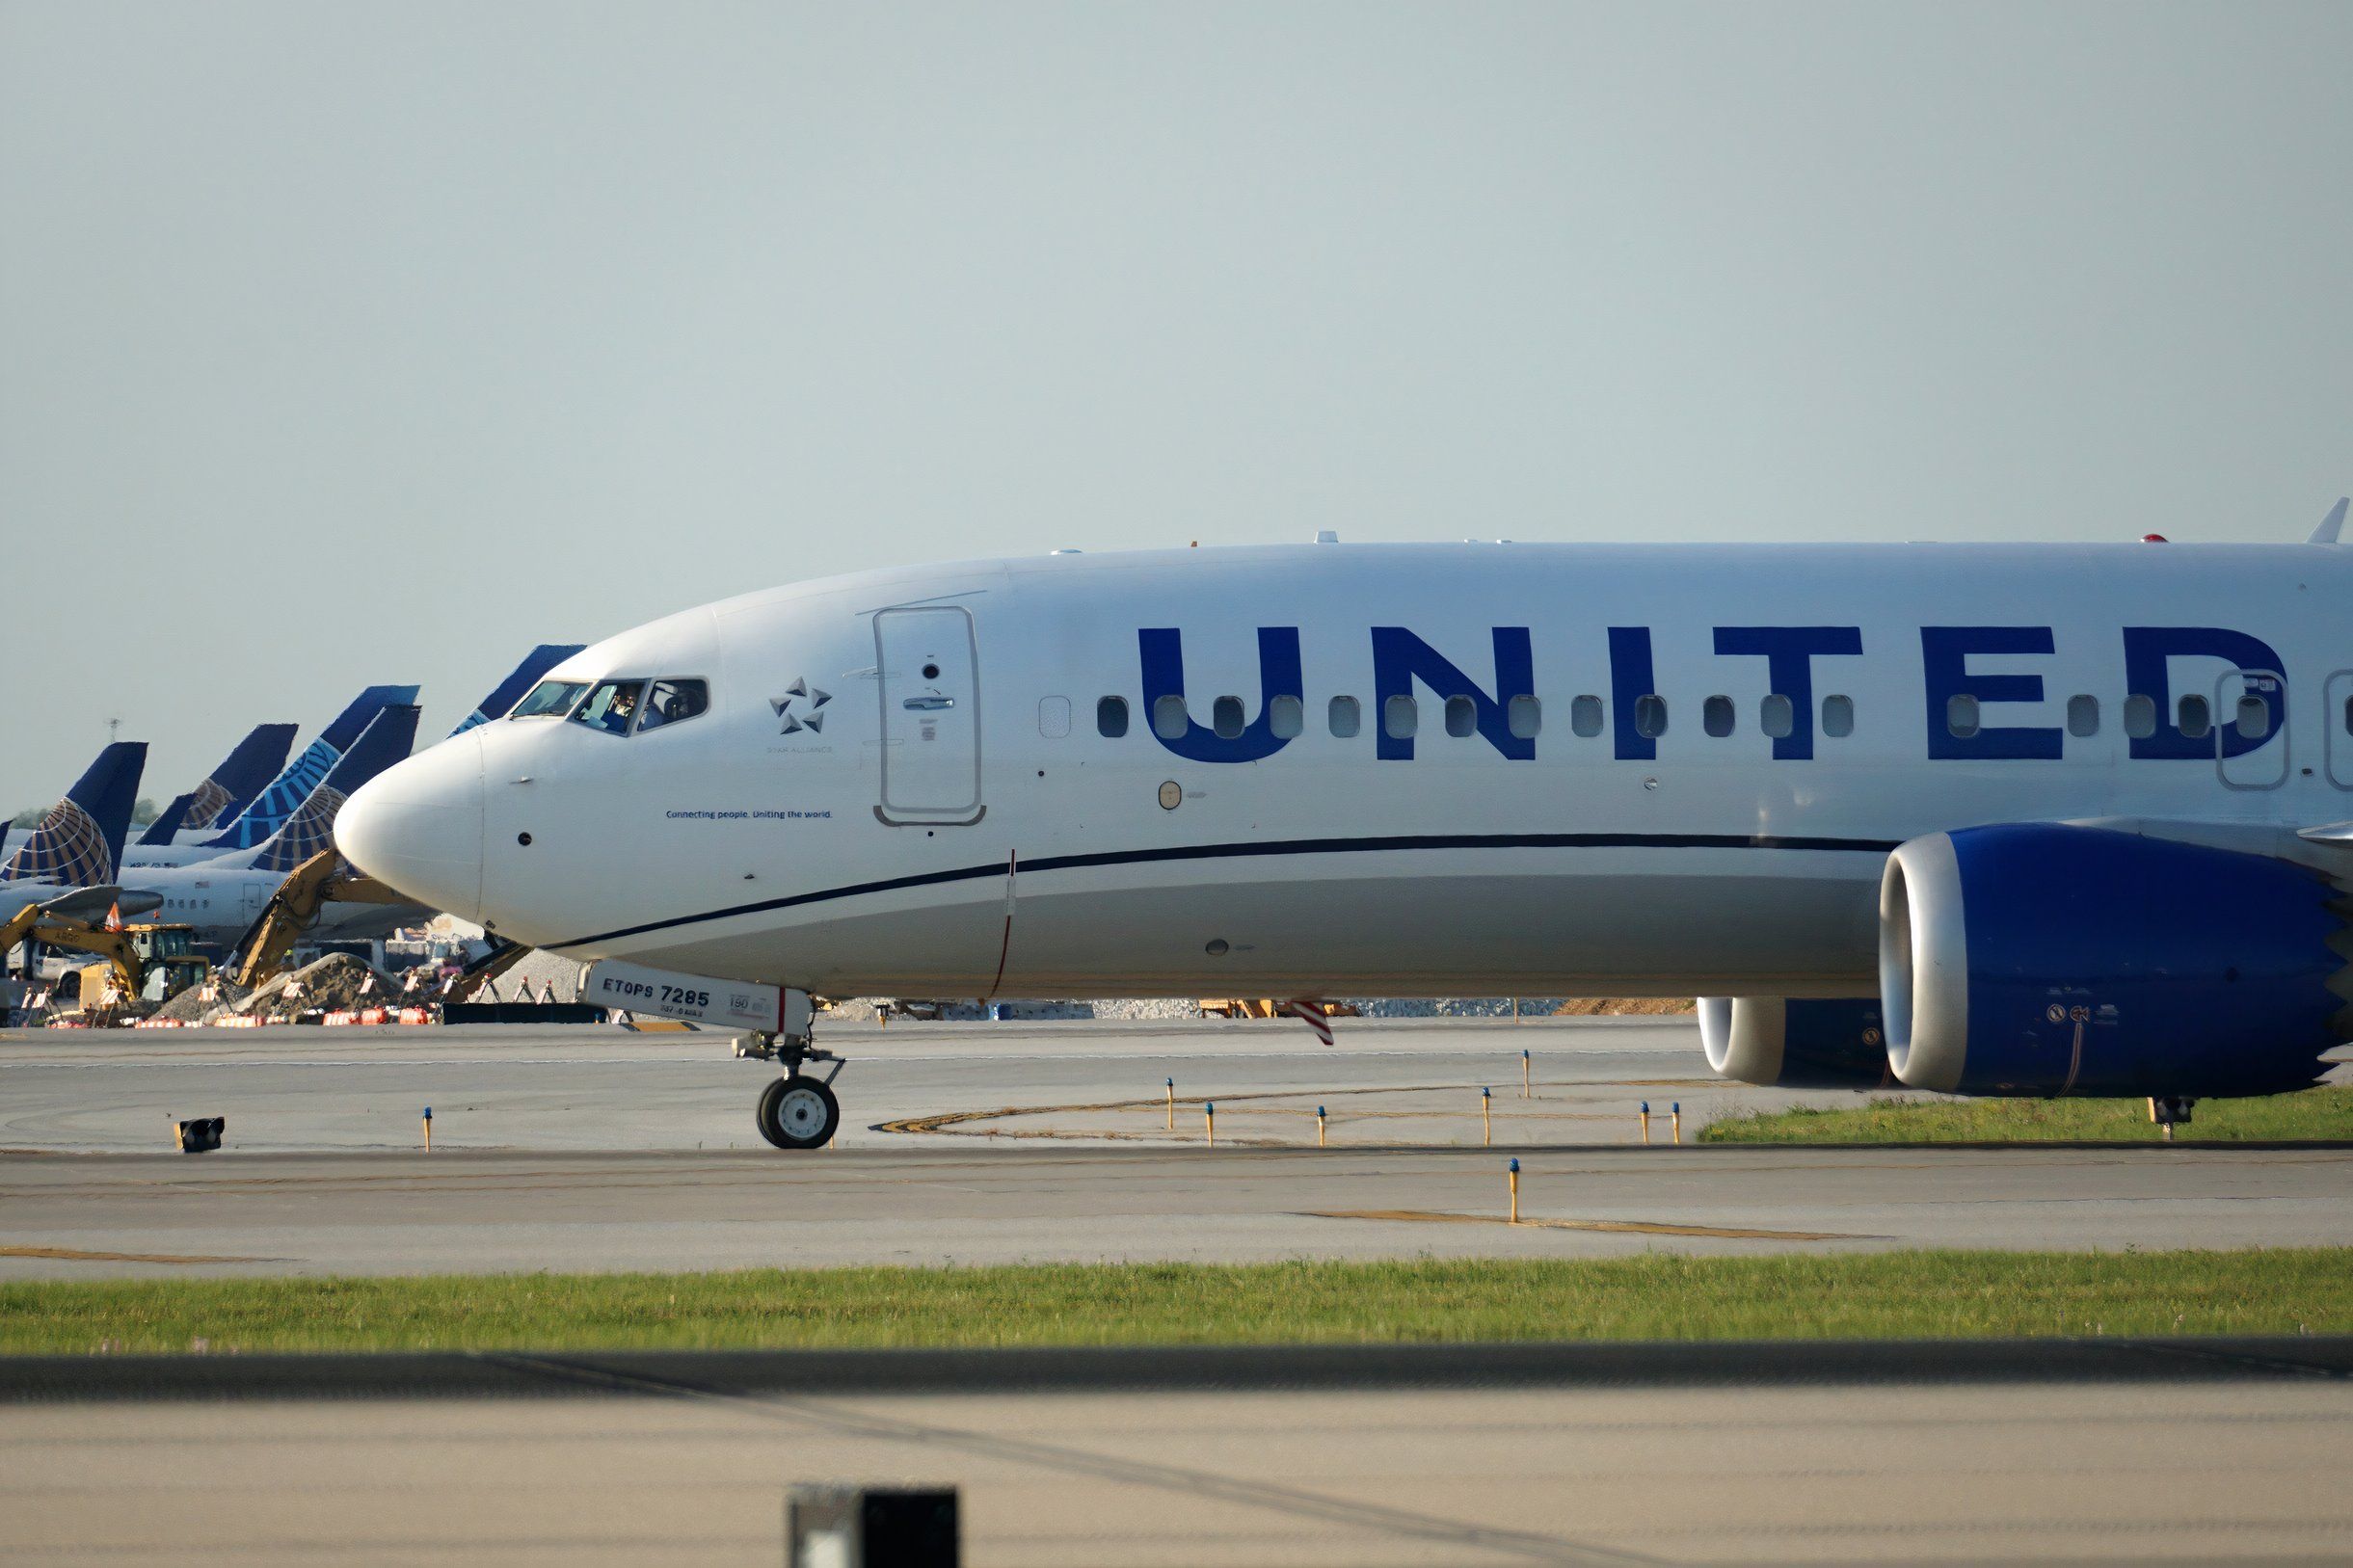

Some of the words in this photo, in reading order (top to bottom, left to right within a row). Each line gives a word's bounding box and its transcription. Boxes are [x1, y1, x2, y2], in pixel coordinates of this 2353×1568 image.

[1138, 626, 2287, 762] UNITED
[666, 810, 715, 819] Connecting
[717, 810, 750, 819] people.
[753, 810, 785, 819] Uniting
[788, 810, 802, 818] the
[805, 810, 833, 818] world.
[602, 977, 653, 997] ETOPS
[661, 985, 709, 1007] 7285
